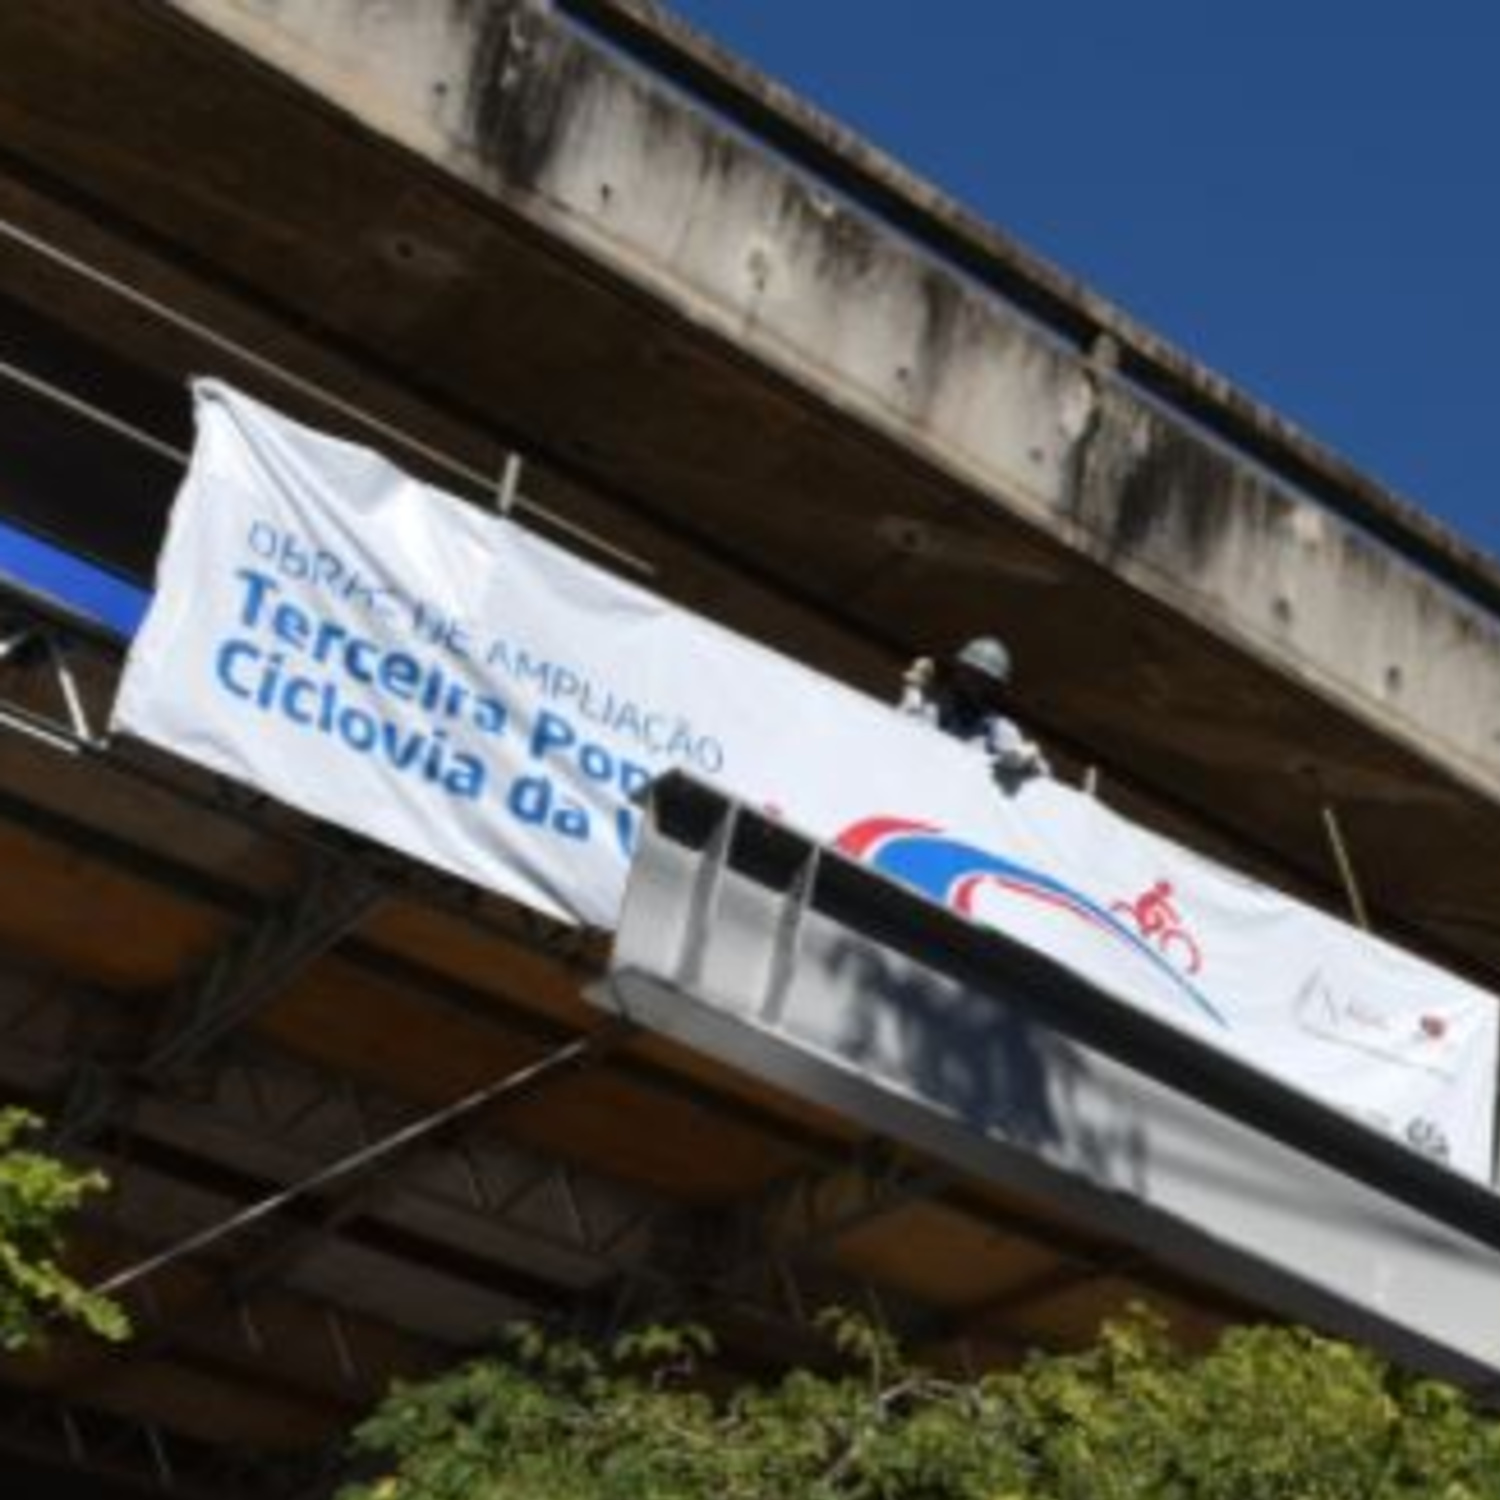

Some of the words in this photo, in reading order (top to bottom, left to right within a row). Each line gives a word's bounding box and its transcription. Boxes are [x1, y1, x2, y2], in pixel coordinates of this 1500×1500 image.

[215, 638, 485, 800] Ciclovia
[506, 773, 591, 841] da
[235, 566, 509, 735] Terceira
[529, 707, 652, 796] Pon
[486, 638, 724, 773] AMPLIAÇÃO
